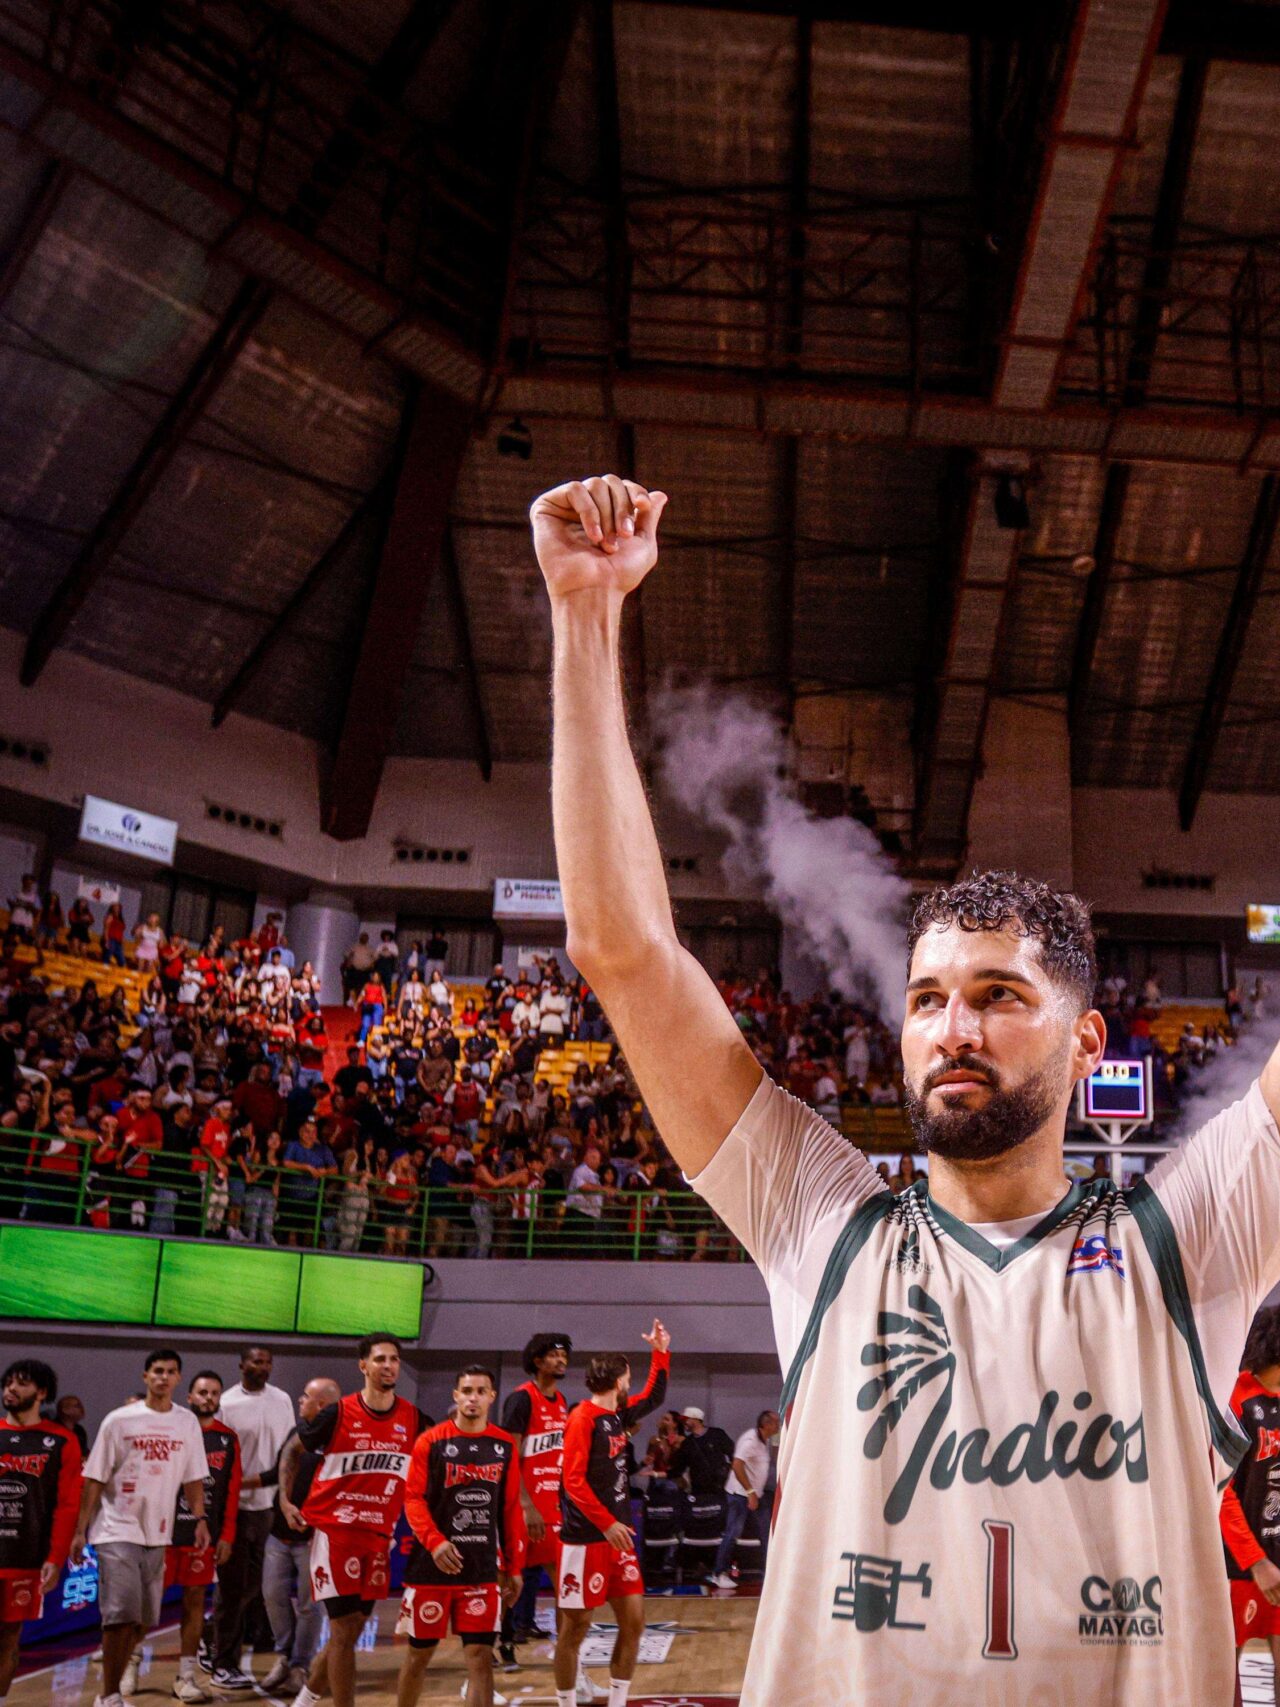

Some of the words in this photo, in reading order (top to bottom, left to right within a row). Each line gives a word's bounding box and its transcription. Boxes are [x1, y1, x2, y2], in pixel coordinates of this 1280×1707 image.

[341, 1453, 405, 1475] LEONES
[882, 1352, 1149, 1525] Indios
[982, 1519, 1018, 1660] 1
